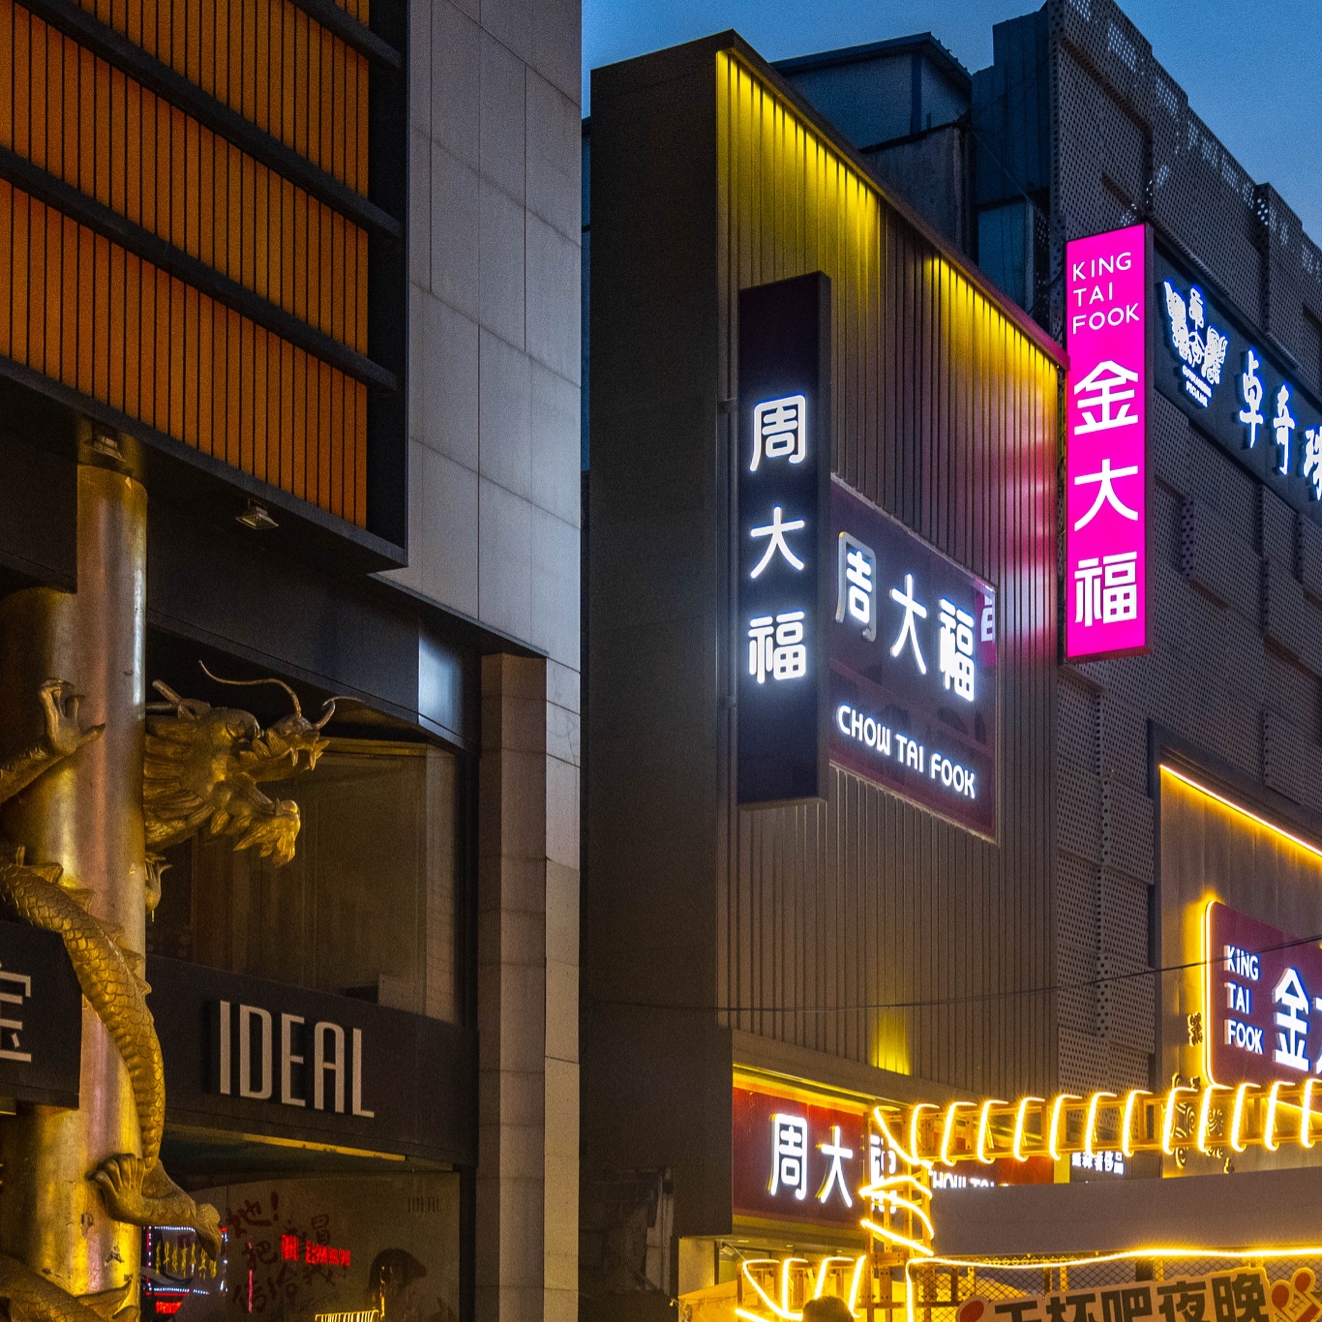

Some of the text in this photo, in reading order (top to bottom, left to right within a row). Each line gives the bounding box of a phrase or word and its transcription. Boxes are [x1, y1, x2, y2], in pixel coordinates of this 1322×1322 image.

[1072, 251, 1132, 282] KING
[1073, 281, 1115, 309] TAI
[1072, 302, 1140, 335] FOOK
[1074, 358, 1140, 628] 金大福
[747, 393, 808, 684] 周大福
[836, 531, 976, 702] 周大福
[837, 704, 977, 800] CHOW TAI FOOK
[1225, 944, 1260, 982] KING
[1225, 982, 1252, 1011] TAI
[1225, 1018, 1264, 1056] FOOK
[219, 999, 376, 1119] IDEAL
